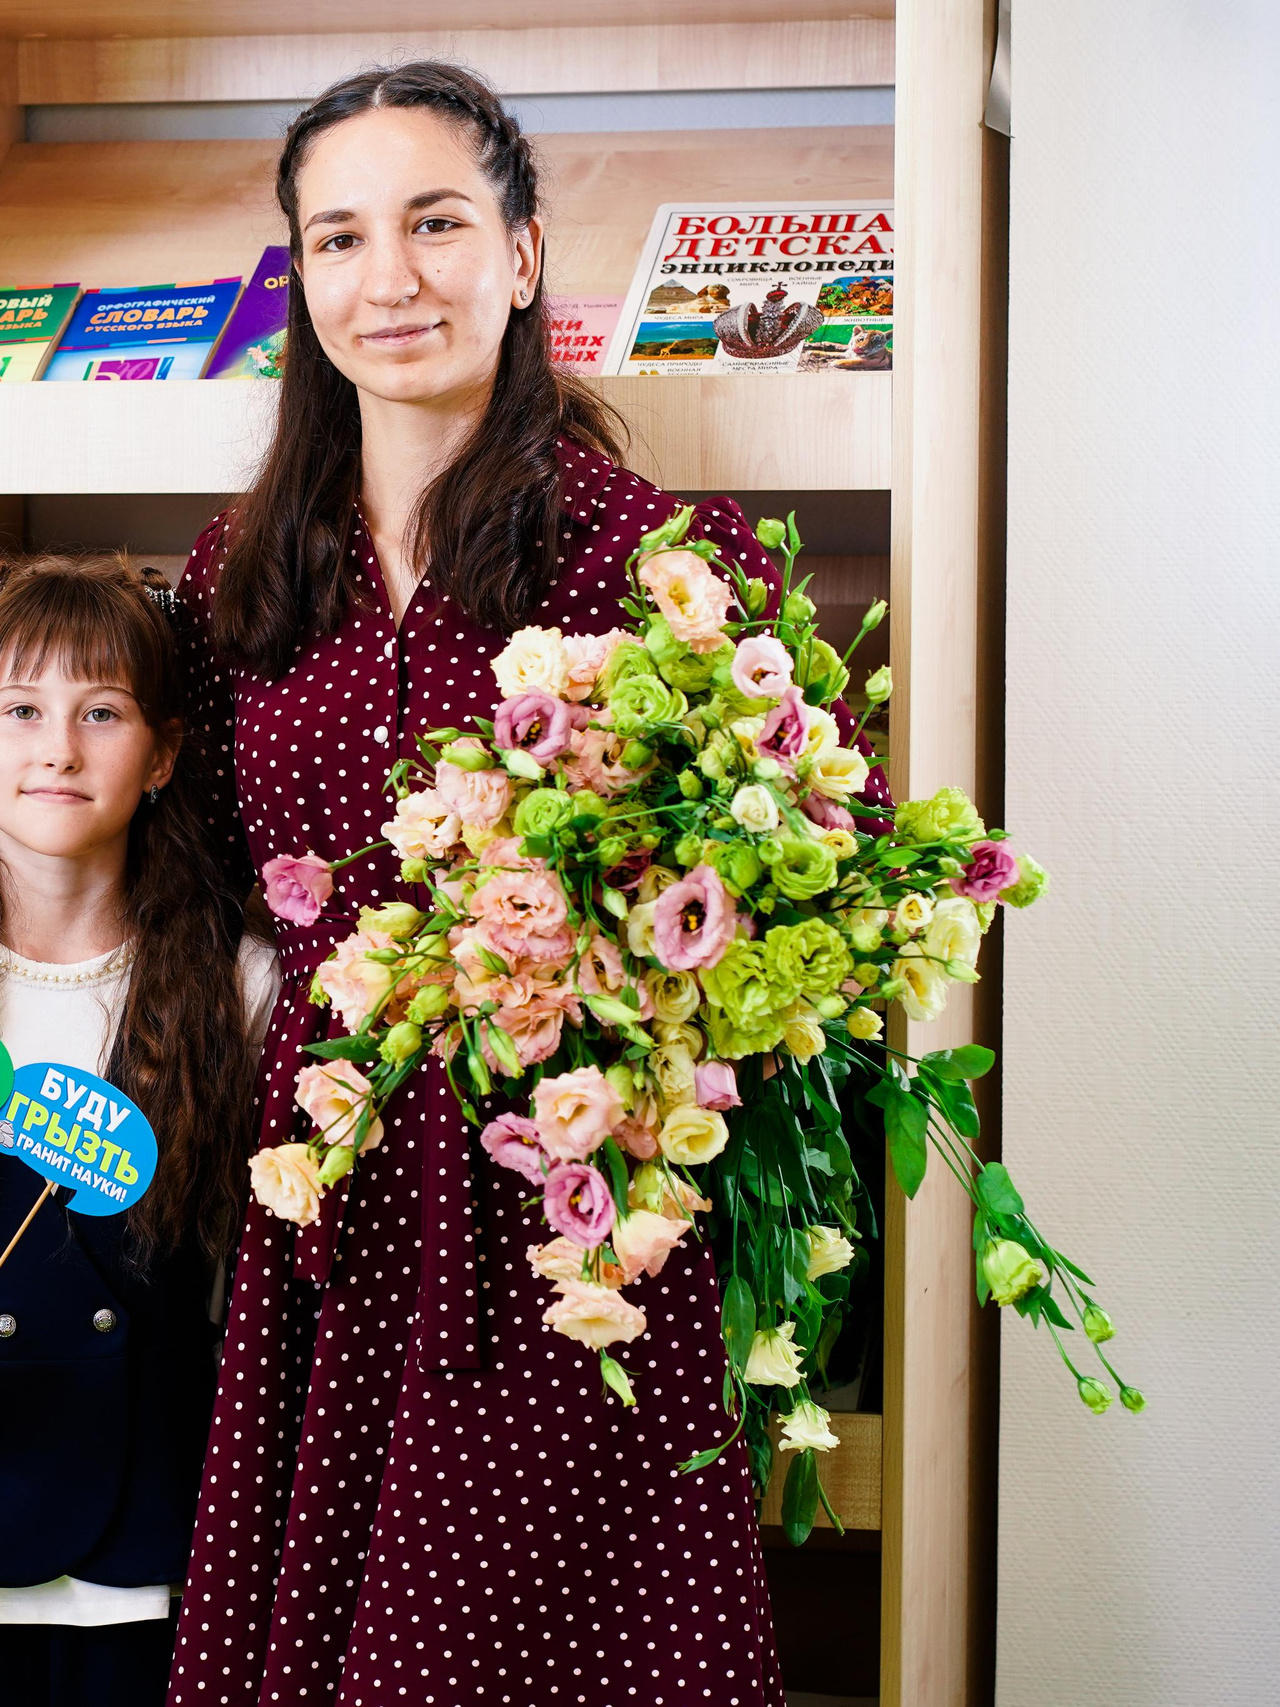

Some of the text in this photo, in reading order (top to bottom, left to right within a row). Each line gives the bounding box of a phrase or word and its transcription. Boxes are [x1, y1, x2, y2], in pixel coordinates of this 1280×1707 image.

[663, 234, 894, 262] ДЕТСКА
[90, 305, 209, 324] СЛОВАРЬ
[97, 295, 216, 311] ОРФОГРАФИЧЕСКИЙ
[85, 319, 203, 333] РУССКОГО ЯЗЫКА
[39, 1067, 131, 1134] БУДУ
[5, 1091, 140, 1186] ГРЫЗТЬ
[16, 1133, 127, 1204] ГРАНИТ НАУКИ!
